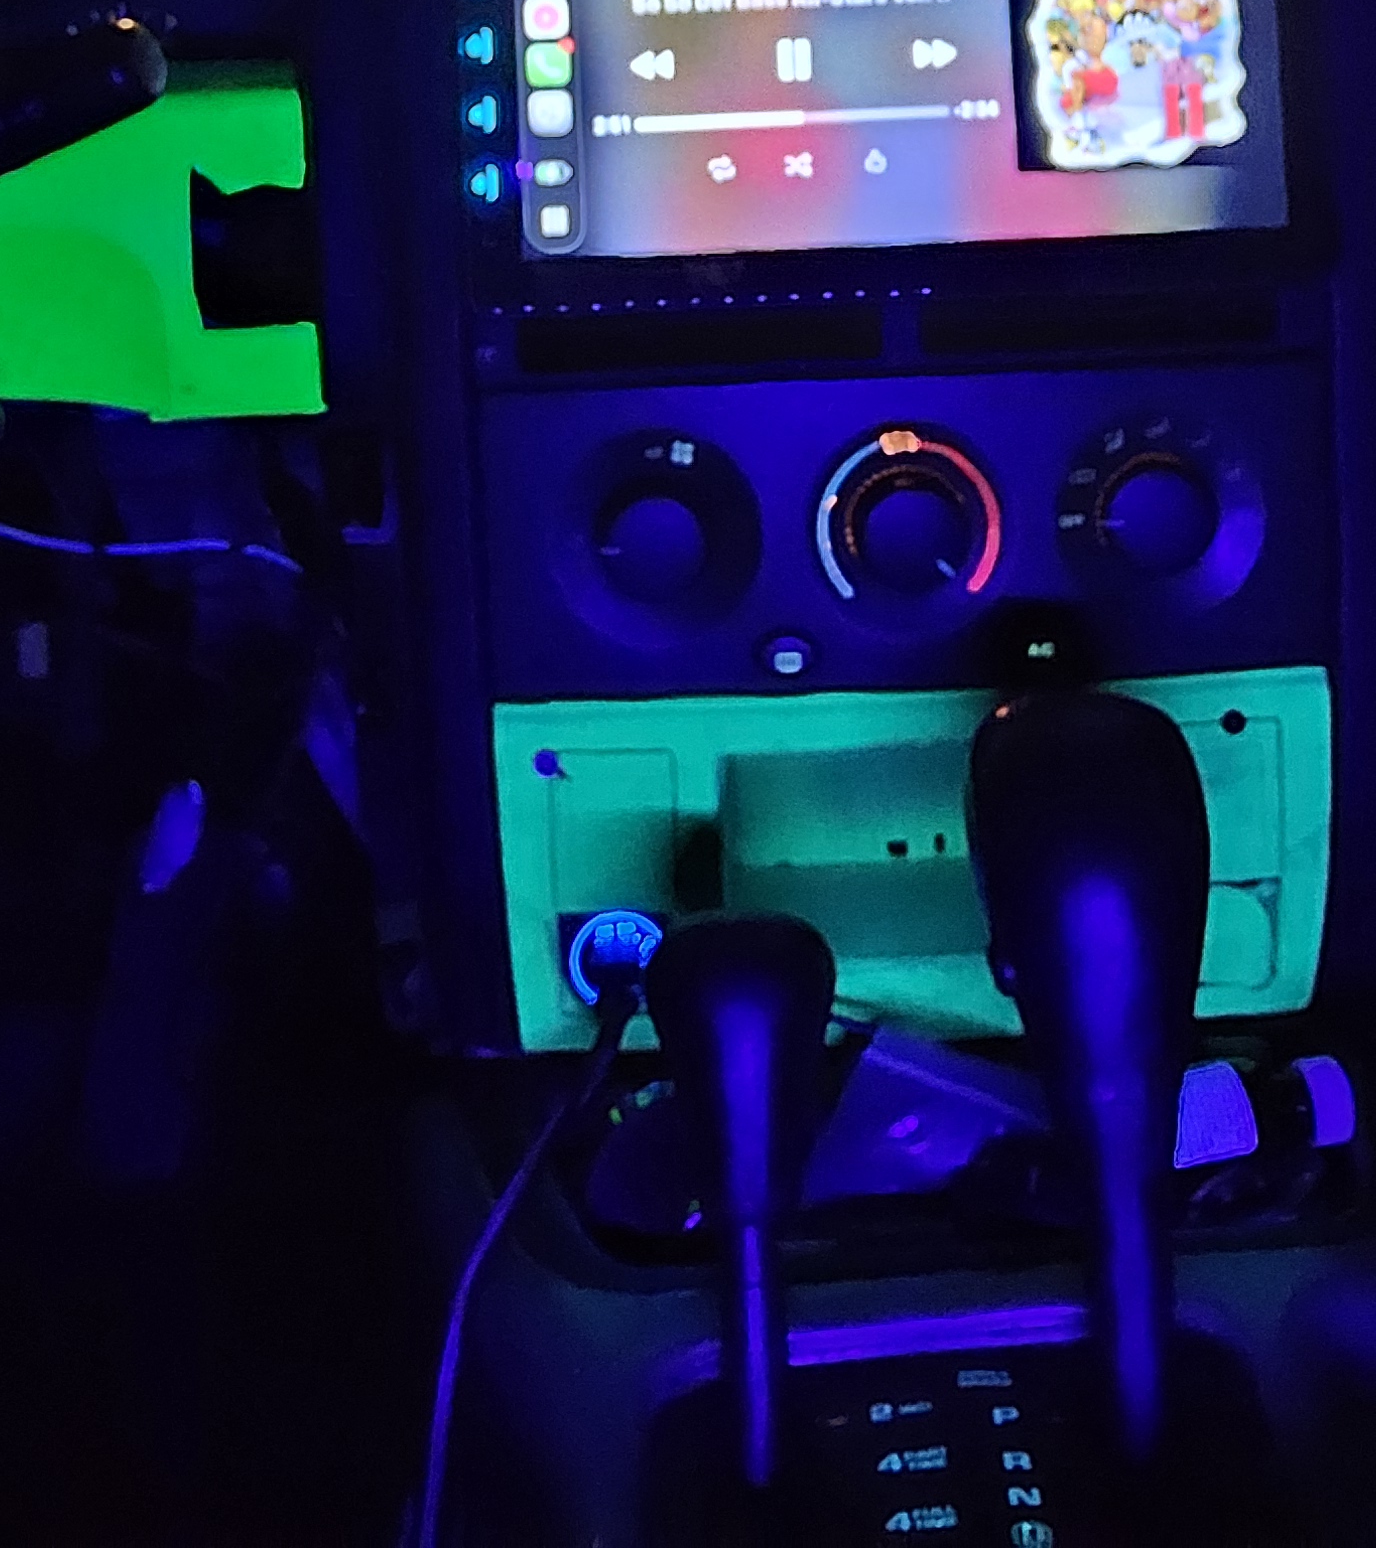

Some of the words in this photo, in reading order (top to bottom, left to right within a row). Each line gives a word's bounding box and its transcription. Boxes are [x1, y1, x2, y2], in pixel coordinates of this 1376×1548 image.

[992, 1406, 1020, 1425] P
[877, 1453, 902, 1472] 4
[1008, 1487, 1041, 1506] N
[885, 1512, 911, 1532] 4
